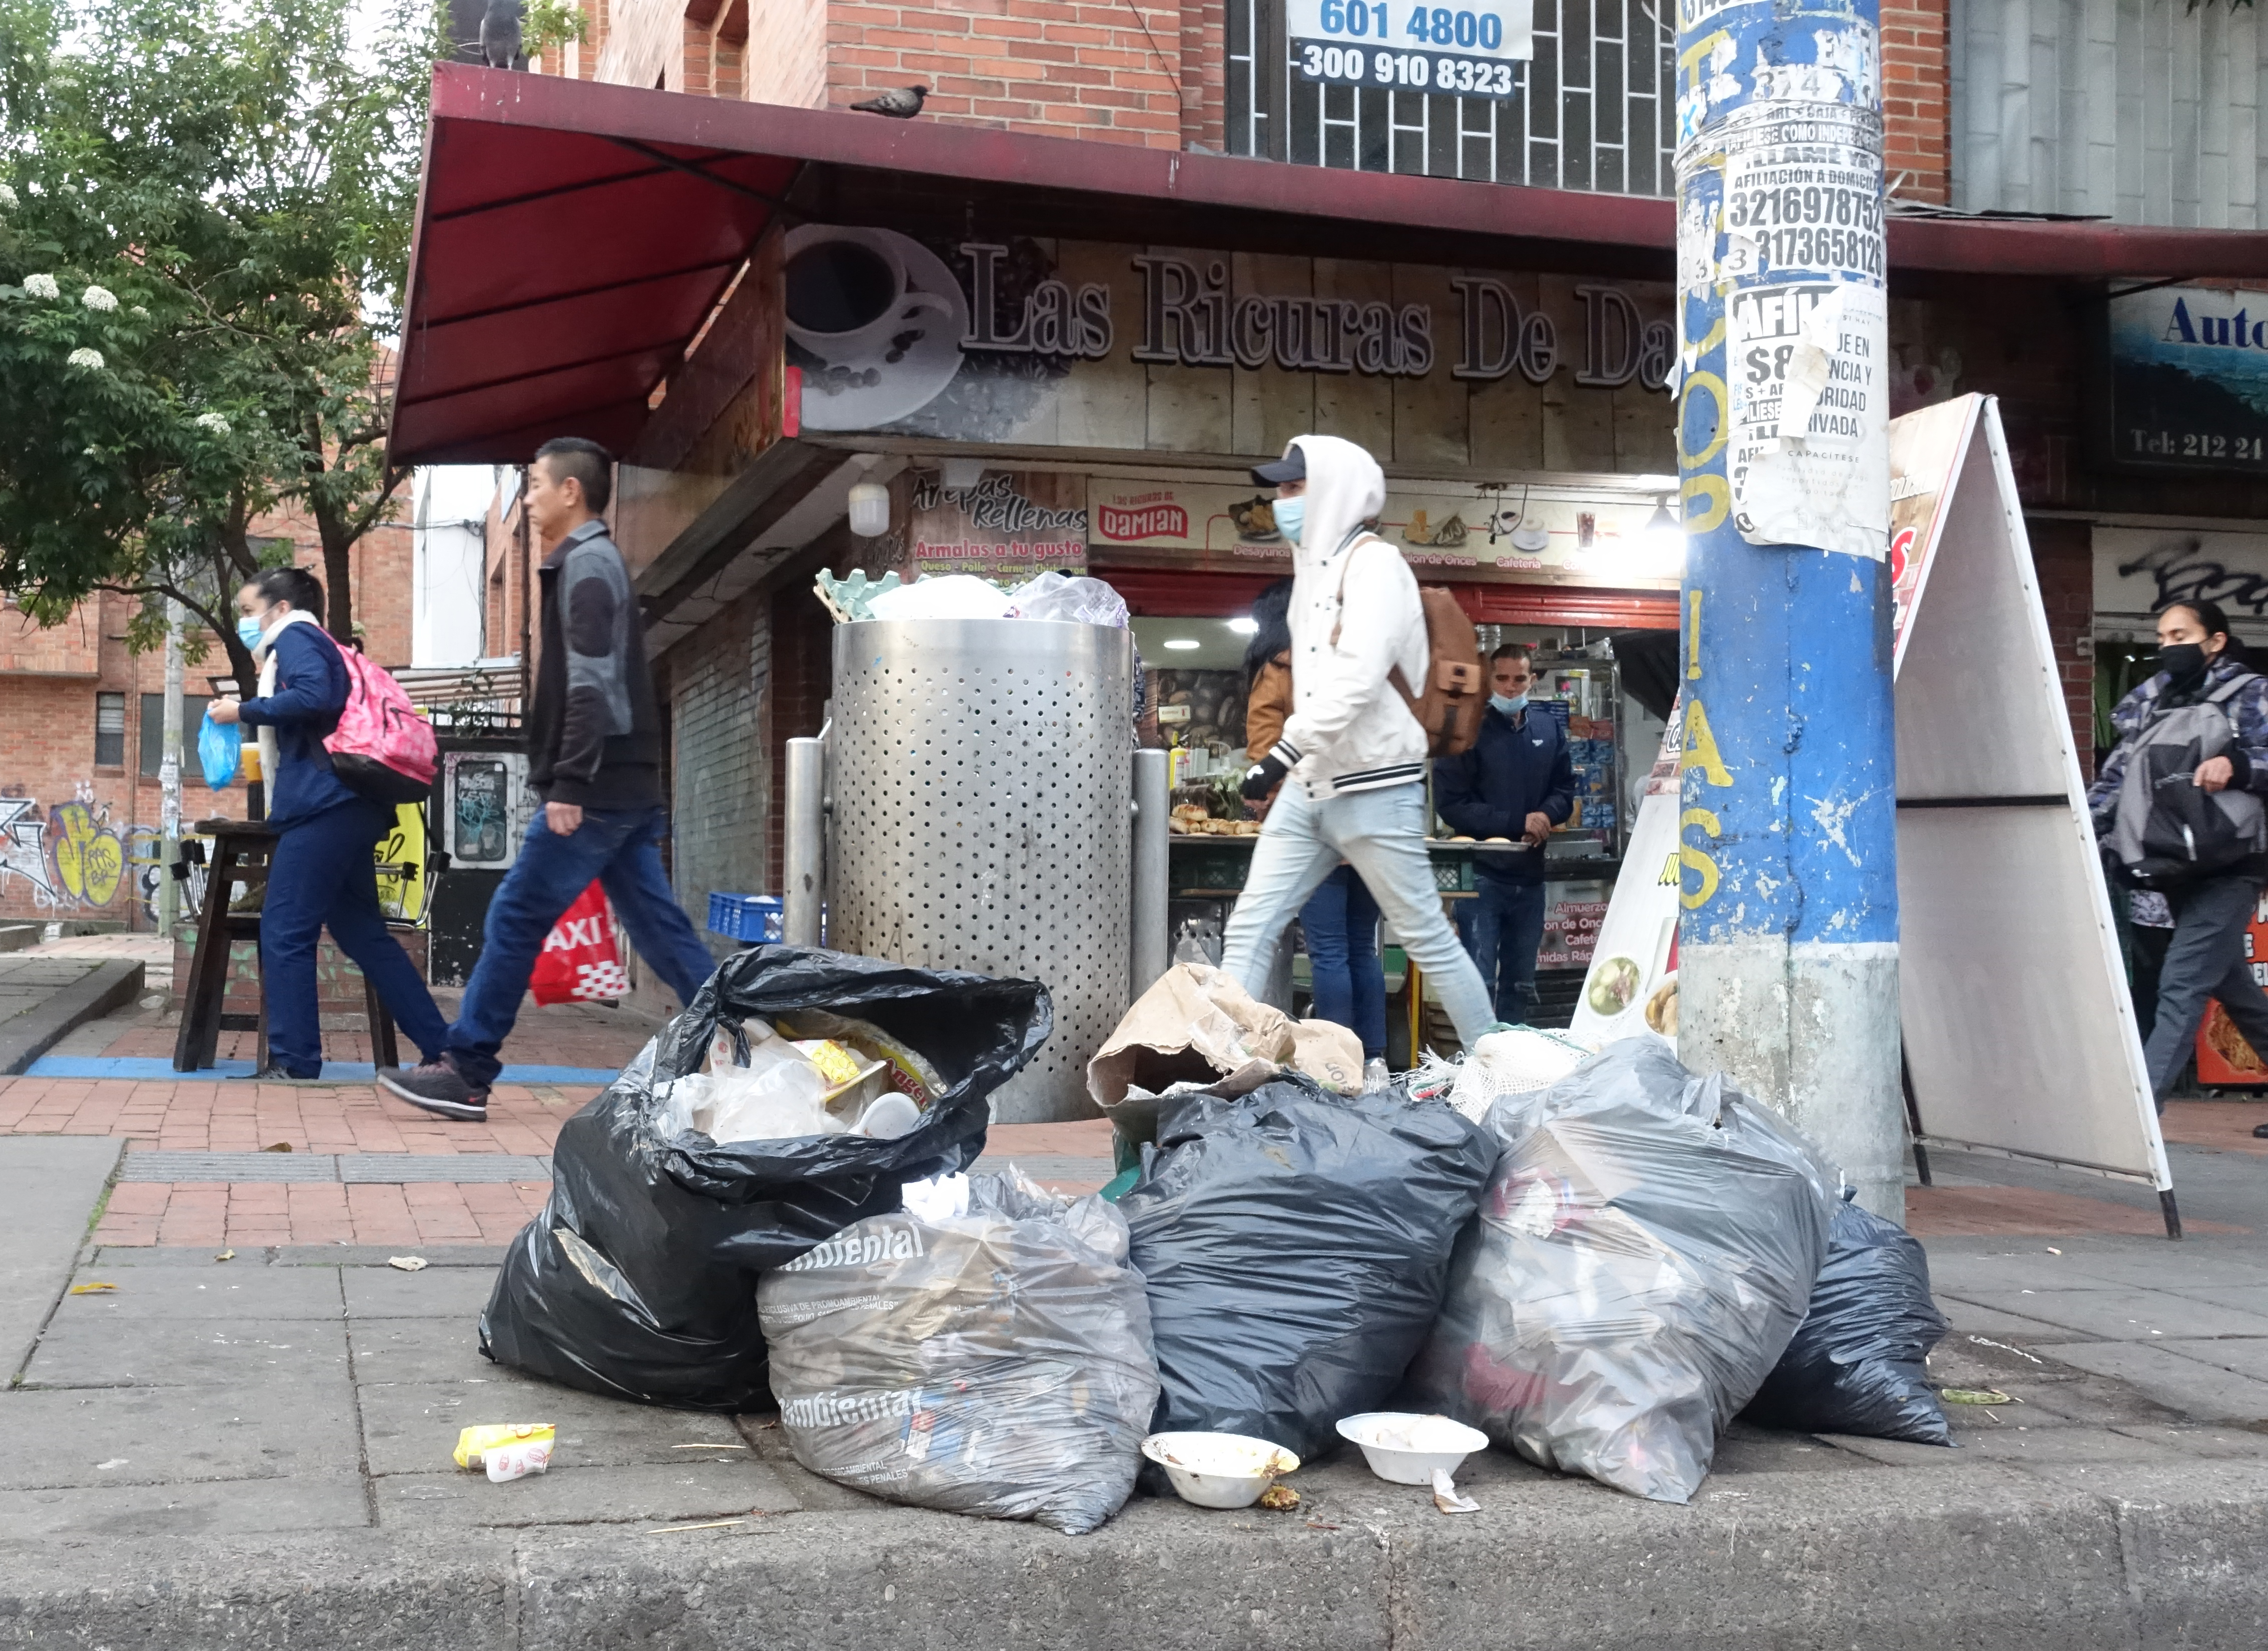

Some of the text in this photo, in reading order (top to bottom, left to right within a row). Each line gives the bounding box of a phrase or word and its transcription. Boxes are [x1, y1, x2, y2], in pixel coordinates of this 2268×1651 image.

[1320, 0, 1502, 50] 601 4800
[1303, 46, 1512, 95] 300 910 8323
[1782, 124, 1816, 142] COMO
[1735, 167, 1813, 189] AFILIACIÓN
[1817, 169, 1826, 183] A
[960, 242, 1114, 357] Las
[1132, 254, 1434, 376] Ricuras
[1452, 276, 1557, 383] De
[1855, 336, 1869, 358] EN
[1865, 365, 1872, 386] Y
[1788, 450, 1859, 463] CAPACÍTESE
[2183, 434, 2226, 457] 212
[973, 494, 1087, 532] Rellenas
[995, 542, 1007, 557] a
[1011, 540, 1029, 557] tu
[1033, 538, 1084, 561] gusto
[1428, 552, 1443, 565] de
[1444, 555, 1477, 567] Onces
[921, 561, 951, 572] Queso
[962, 561, 987, 573] Pollo
[997, 562, 1025, 574] Carne
[1561, 918, 1577, 930] de
[801, 1301, 811, 1311] DE
